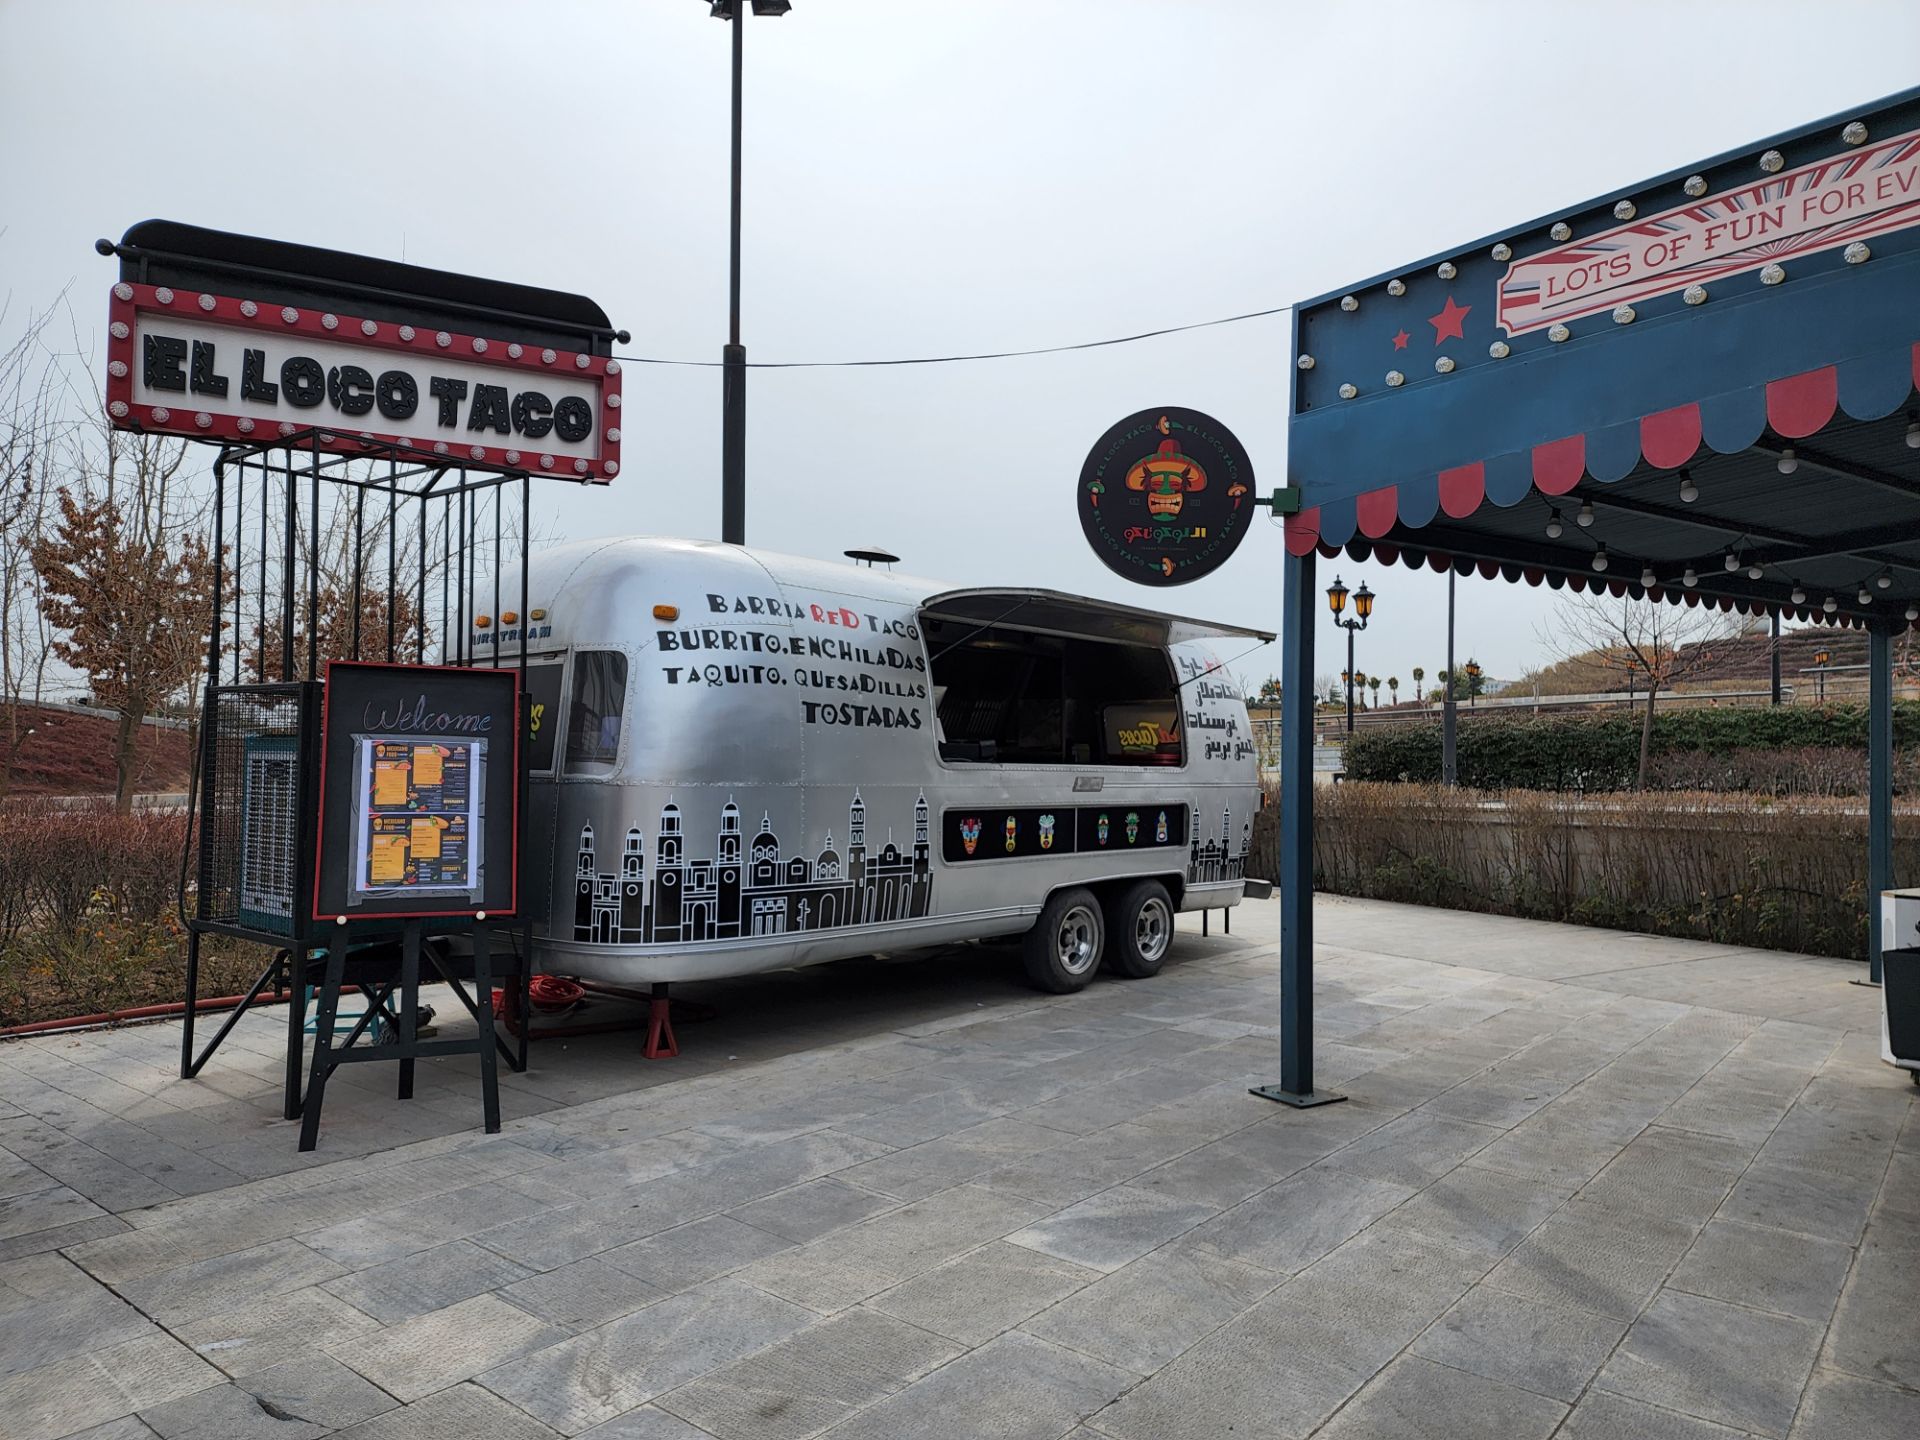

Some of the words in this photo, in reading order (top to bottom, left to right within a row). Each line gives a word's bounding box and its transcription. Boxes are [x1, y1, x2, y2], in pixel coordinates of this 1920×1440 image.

[1547, 253, 1632, 298] LOTS
[1643, 233, 1691, 268] OF
[1704, 205, 1786, 251] FUN
[1802, 182, 1866, 222] FOR
[1877, 165, 1920, 201] EV
[142, 333, 229, 397] EL
[240, 347, 419, 420] LOCO
[429, 375, 592, 443] TACO
[1104, 438, 1125, 461] LOCO
[1126, 424, 1152, 440] TACO
[1187, 425, 1199, 435] EL
[1202, 432, 1224, 453] LOCO
[1223, 453, 1238, 480] TACO
[1100, 526, 1119, 551] LOCO
[1119, 549, 1145, 567] TACO
[1180, 559, 1194, 567] EL
[1197, 540, 1220, 561] LOCO
[1219, 512, 1236, 542] TACO
[706, 593, 805, 619] BARRIA
[864, 613, 919, 641] TACO
[794, 668, 927, 700] QUESADILLAS
[363, 695, 492, 731] Welcome
[802, 700, 922, 730] TOSTADAS
